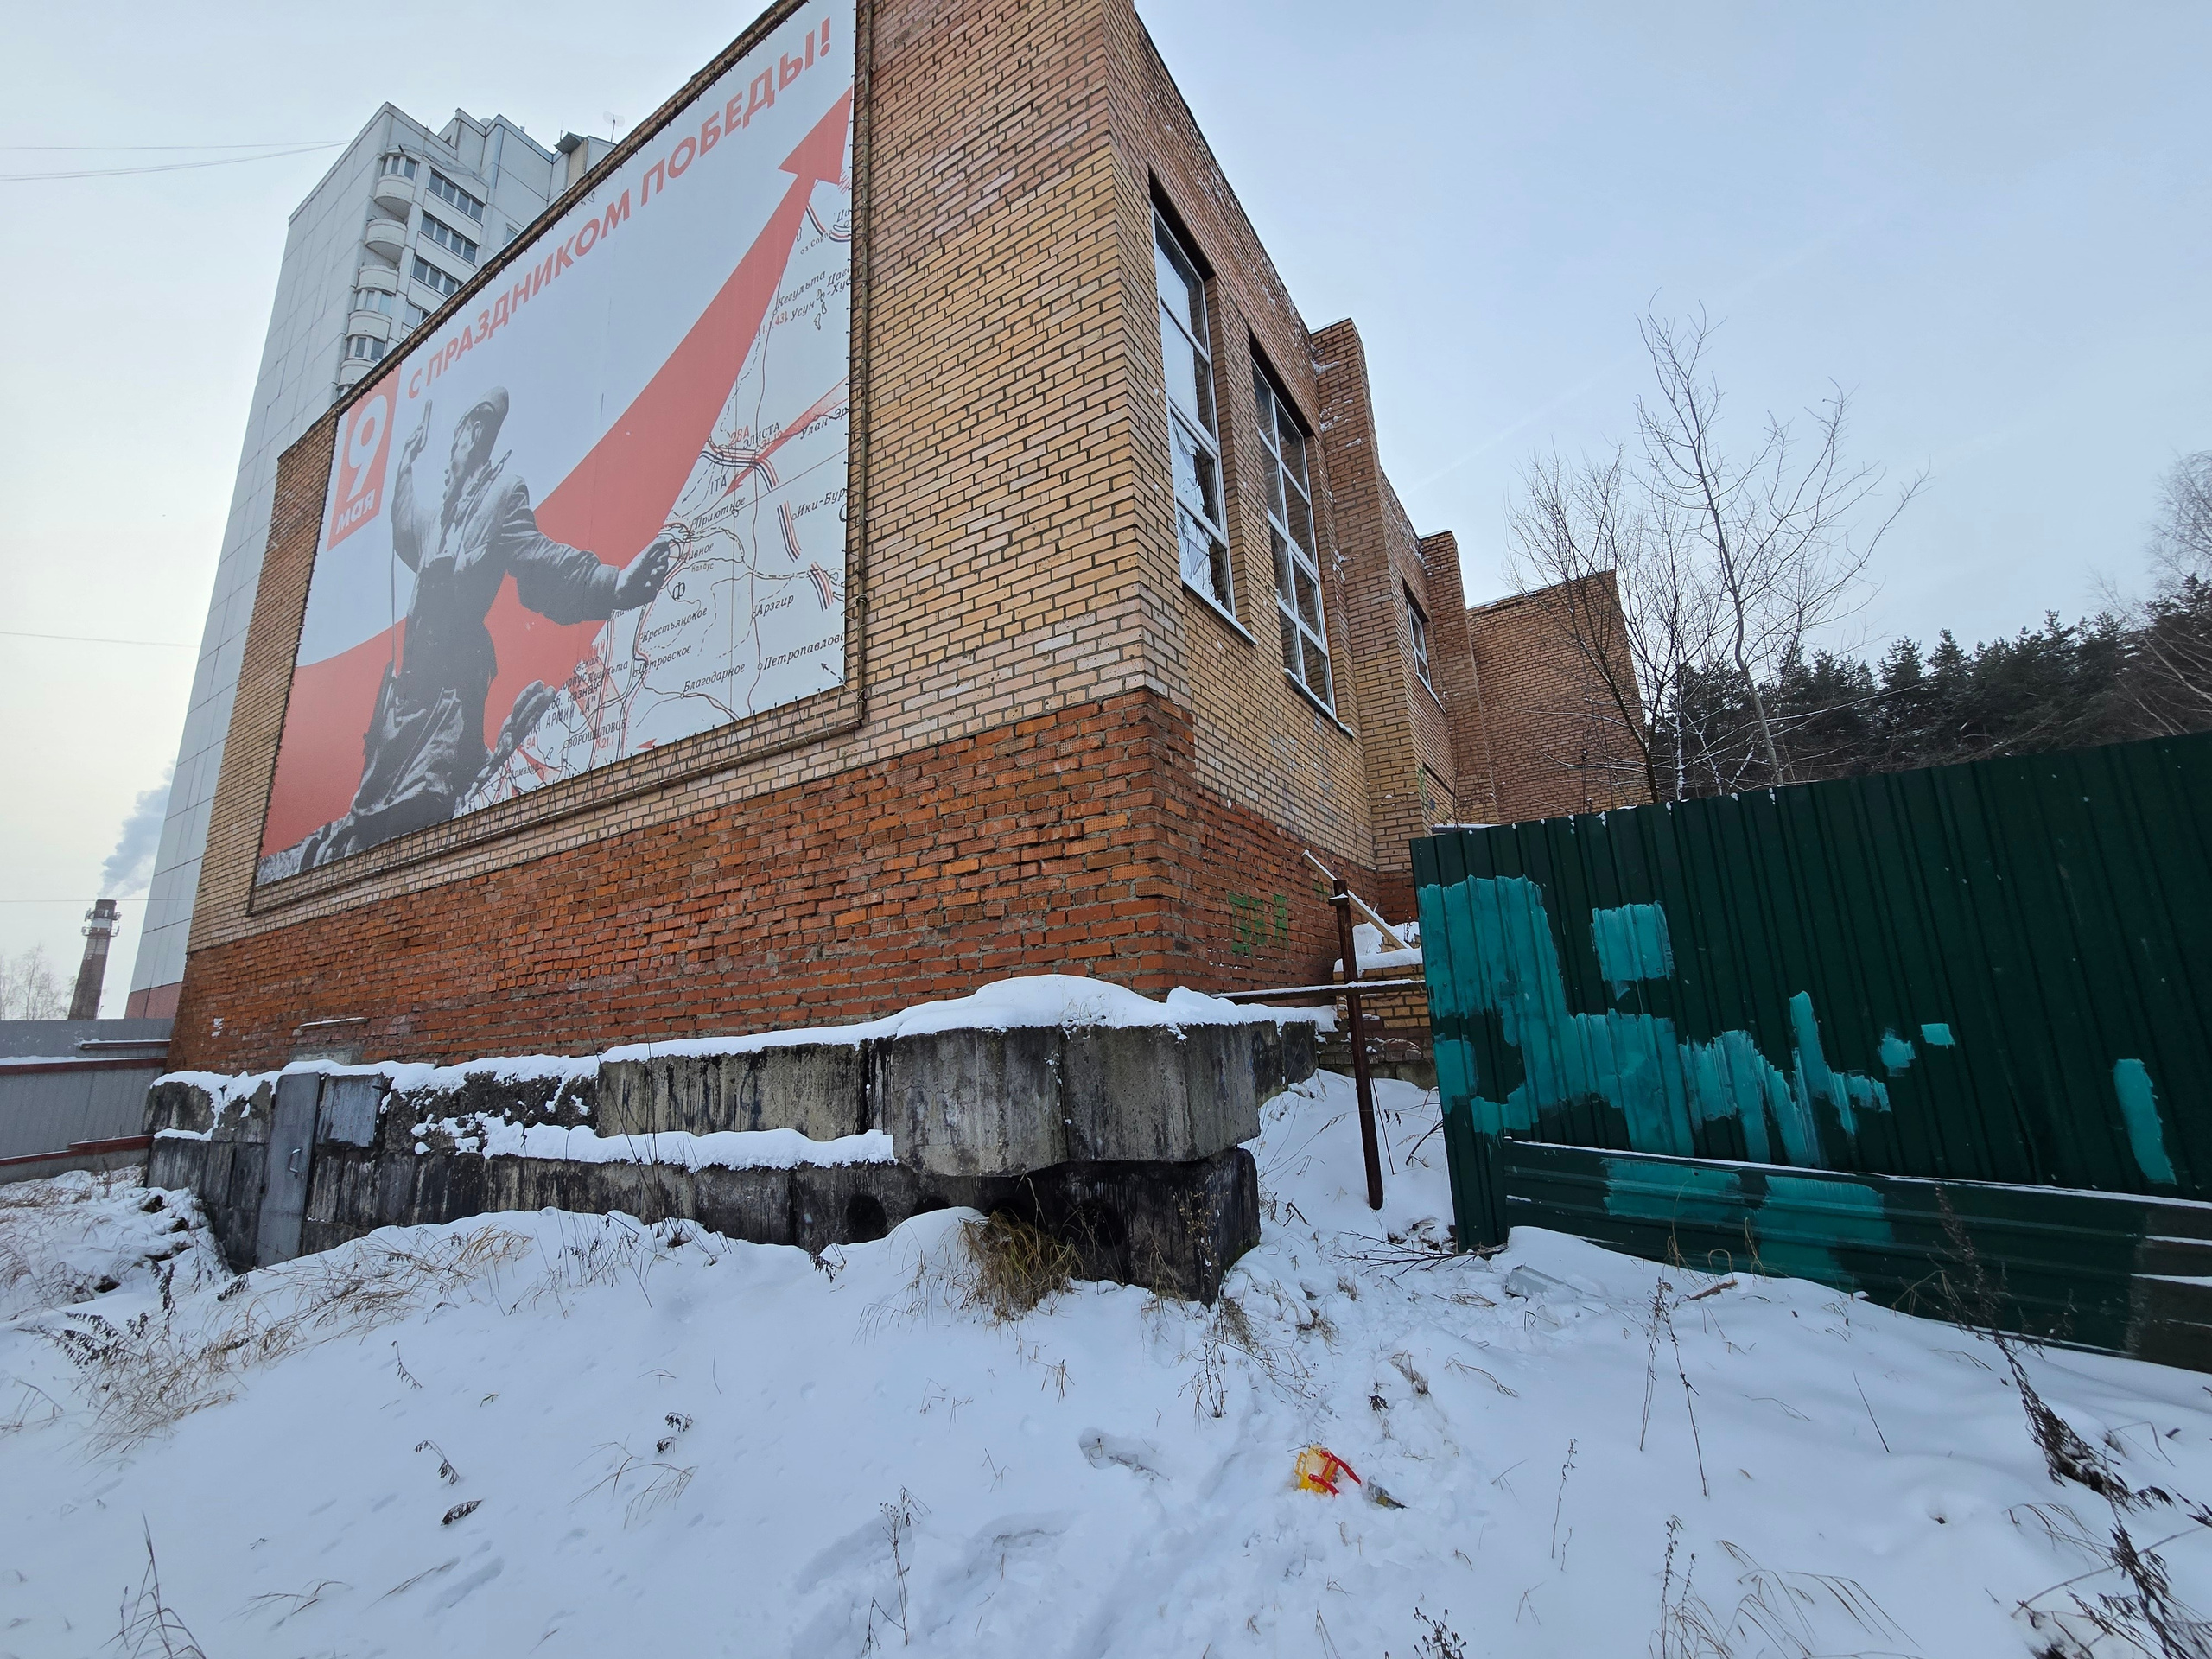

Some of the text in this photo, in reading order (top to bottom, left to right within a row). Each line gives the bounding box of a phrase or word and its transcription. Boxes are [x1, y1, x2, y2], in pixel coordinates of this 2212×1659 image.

[409, 17, 831, 399] С ПРАЗДНИКОМ ПОБЕДЫ!
[777, 270, 826, 309] Кегульта
[348, 394, 388, 503] 9
[672, 581, 686, 601] Ф
[755, 594, 794, 617] Арзгир
[642, 607, 708, 643] Крестьянское
[683, 664, 745, 692] Благодарное
